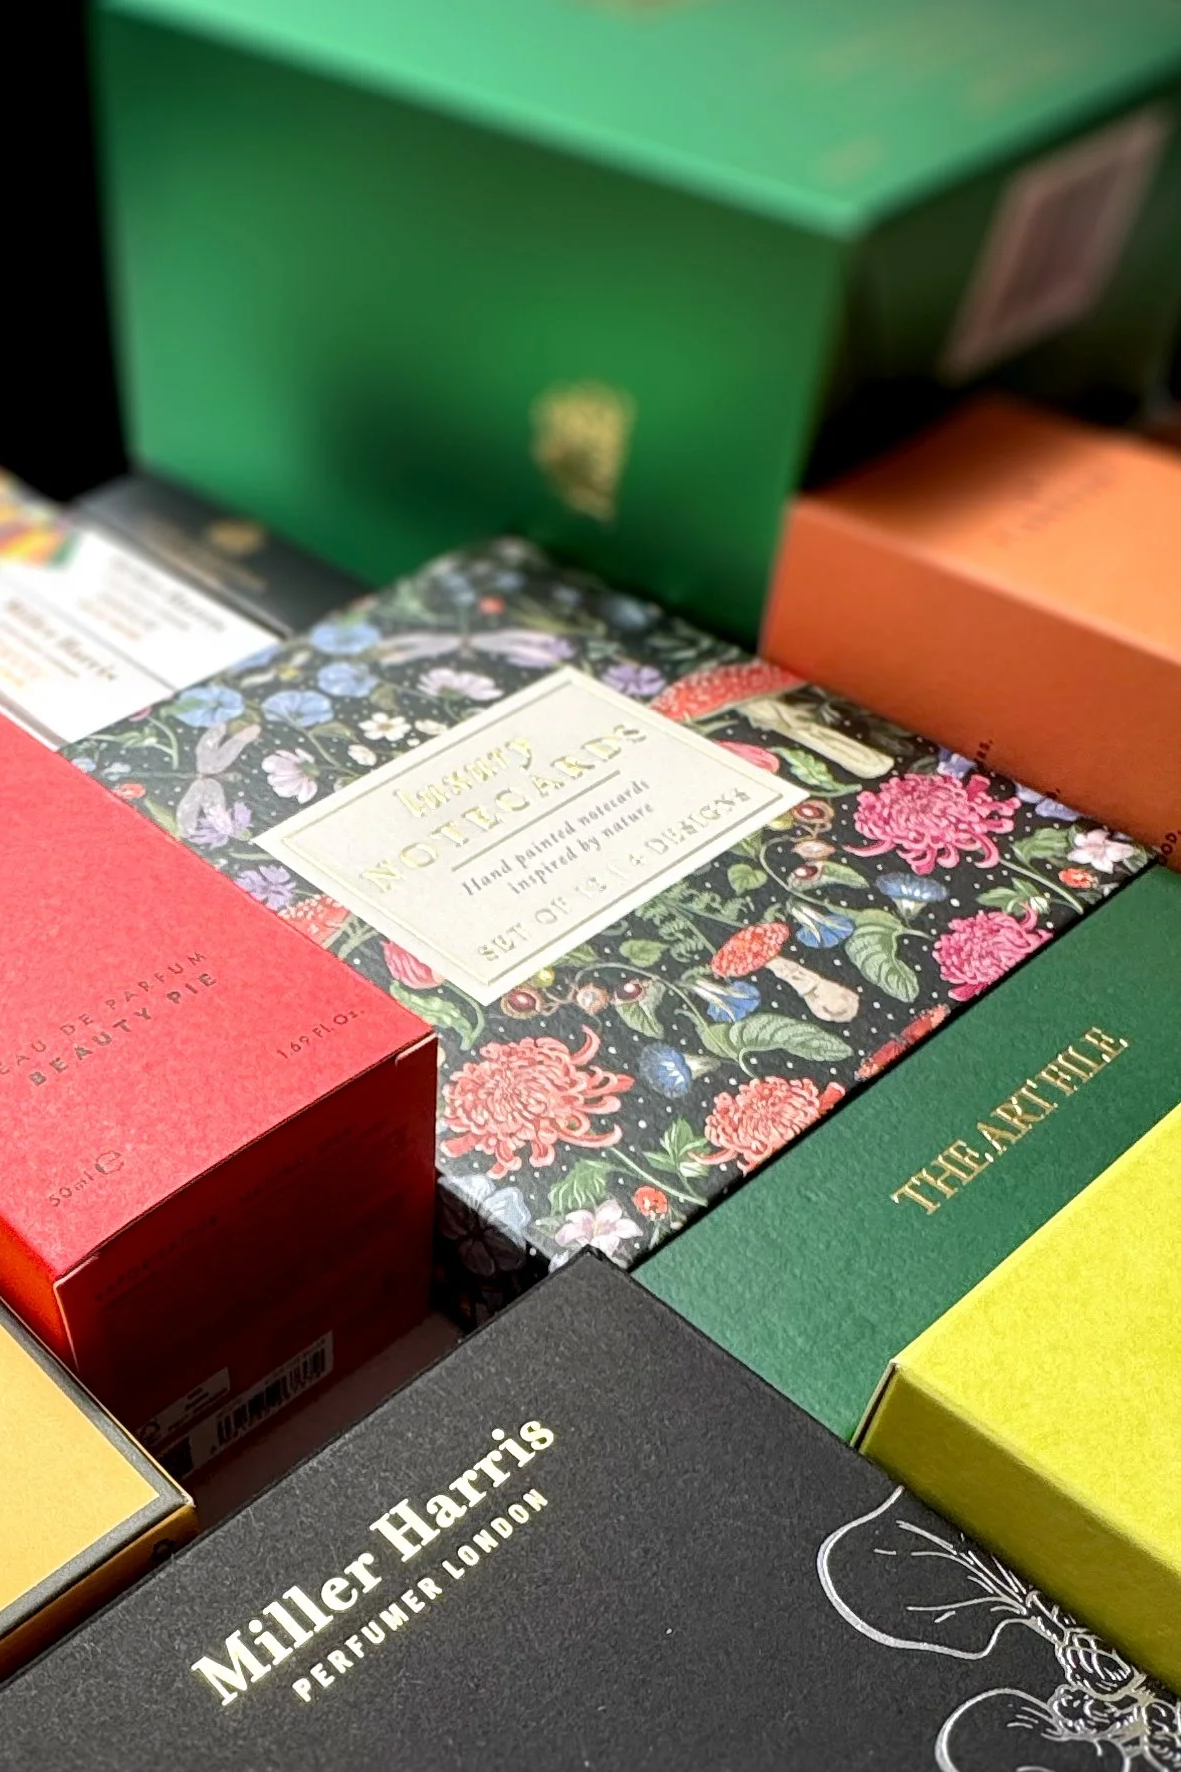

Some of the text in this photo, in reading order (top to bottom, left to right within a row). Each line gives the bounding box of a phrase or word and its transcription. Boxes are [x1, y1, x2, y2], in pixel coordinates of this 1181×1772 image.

[359, 723, 648, 894] NOTECARDS
[460, 778, 650, 897] Hand painted notecards
[477, 922, 532, 963] SET
[534, 895, 572, 926] OF
[644, 787, 752, 855] DESIGNS
[507, 802, 654, 895] inspired by nature
[29, 973, 217, 1086] BEAUTY PIE
[60, 1013, 94, 1036] DE
[105, 952, 206, 1010] PARFUM
[891, 1025, 1129, 1215] THE ART FILE
[190, 1420, 555, 1706] Miller Harris
[292, 1488, 550, 1703] PERFUMER LONDON
